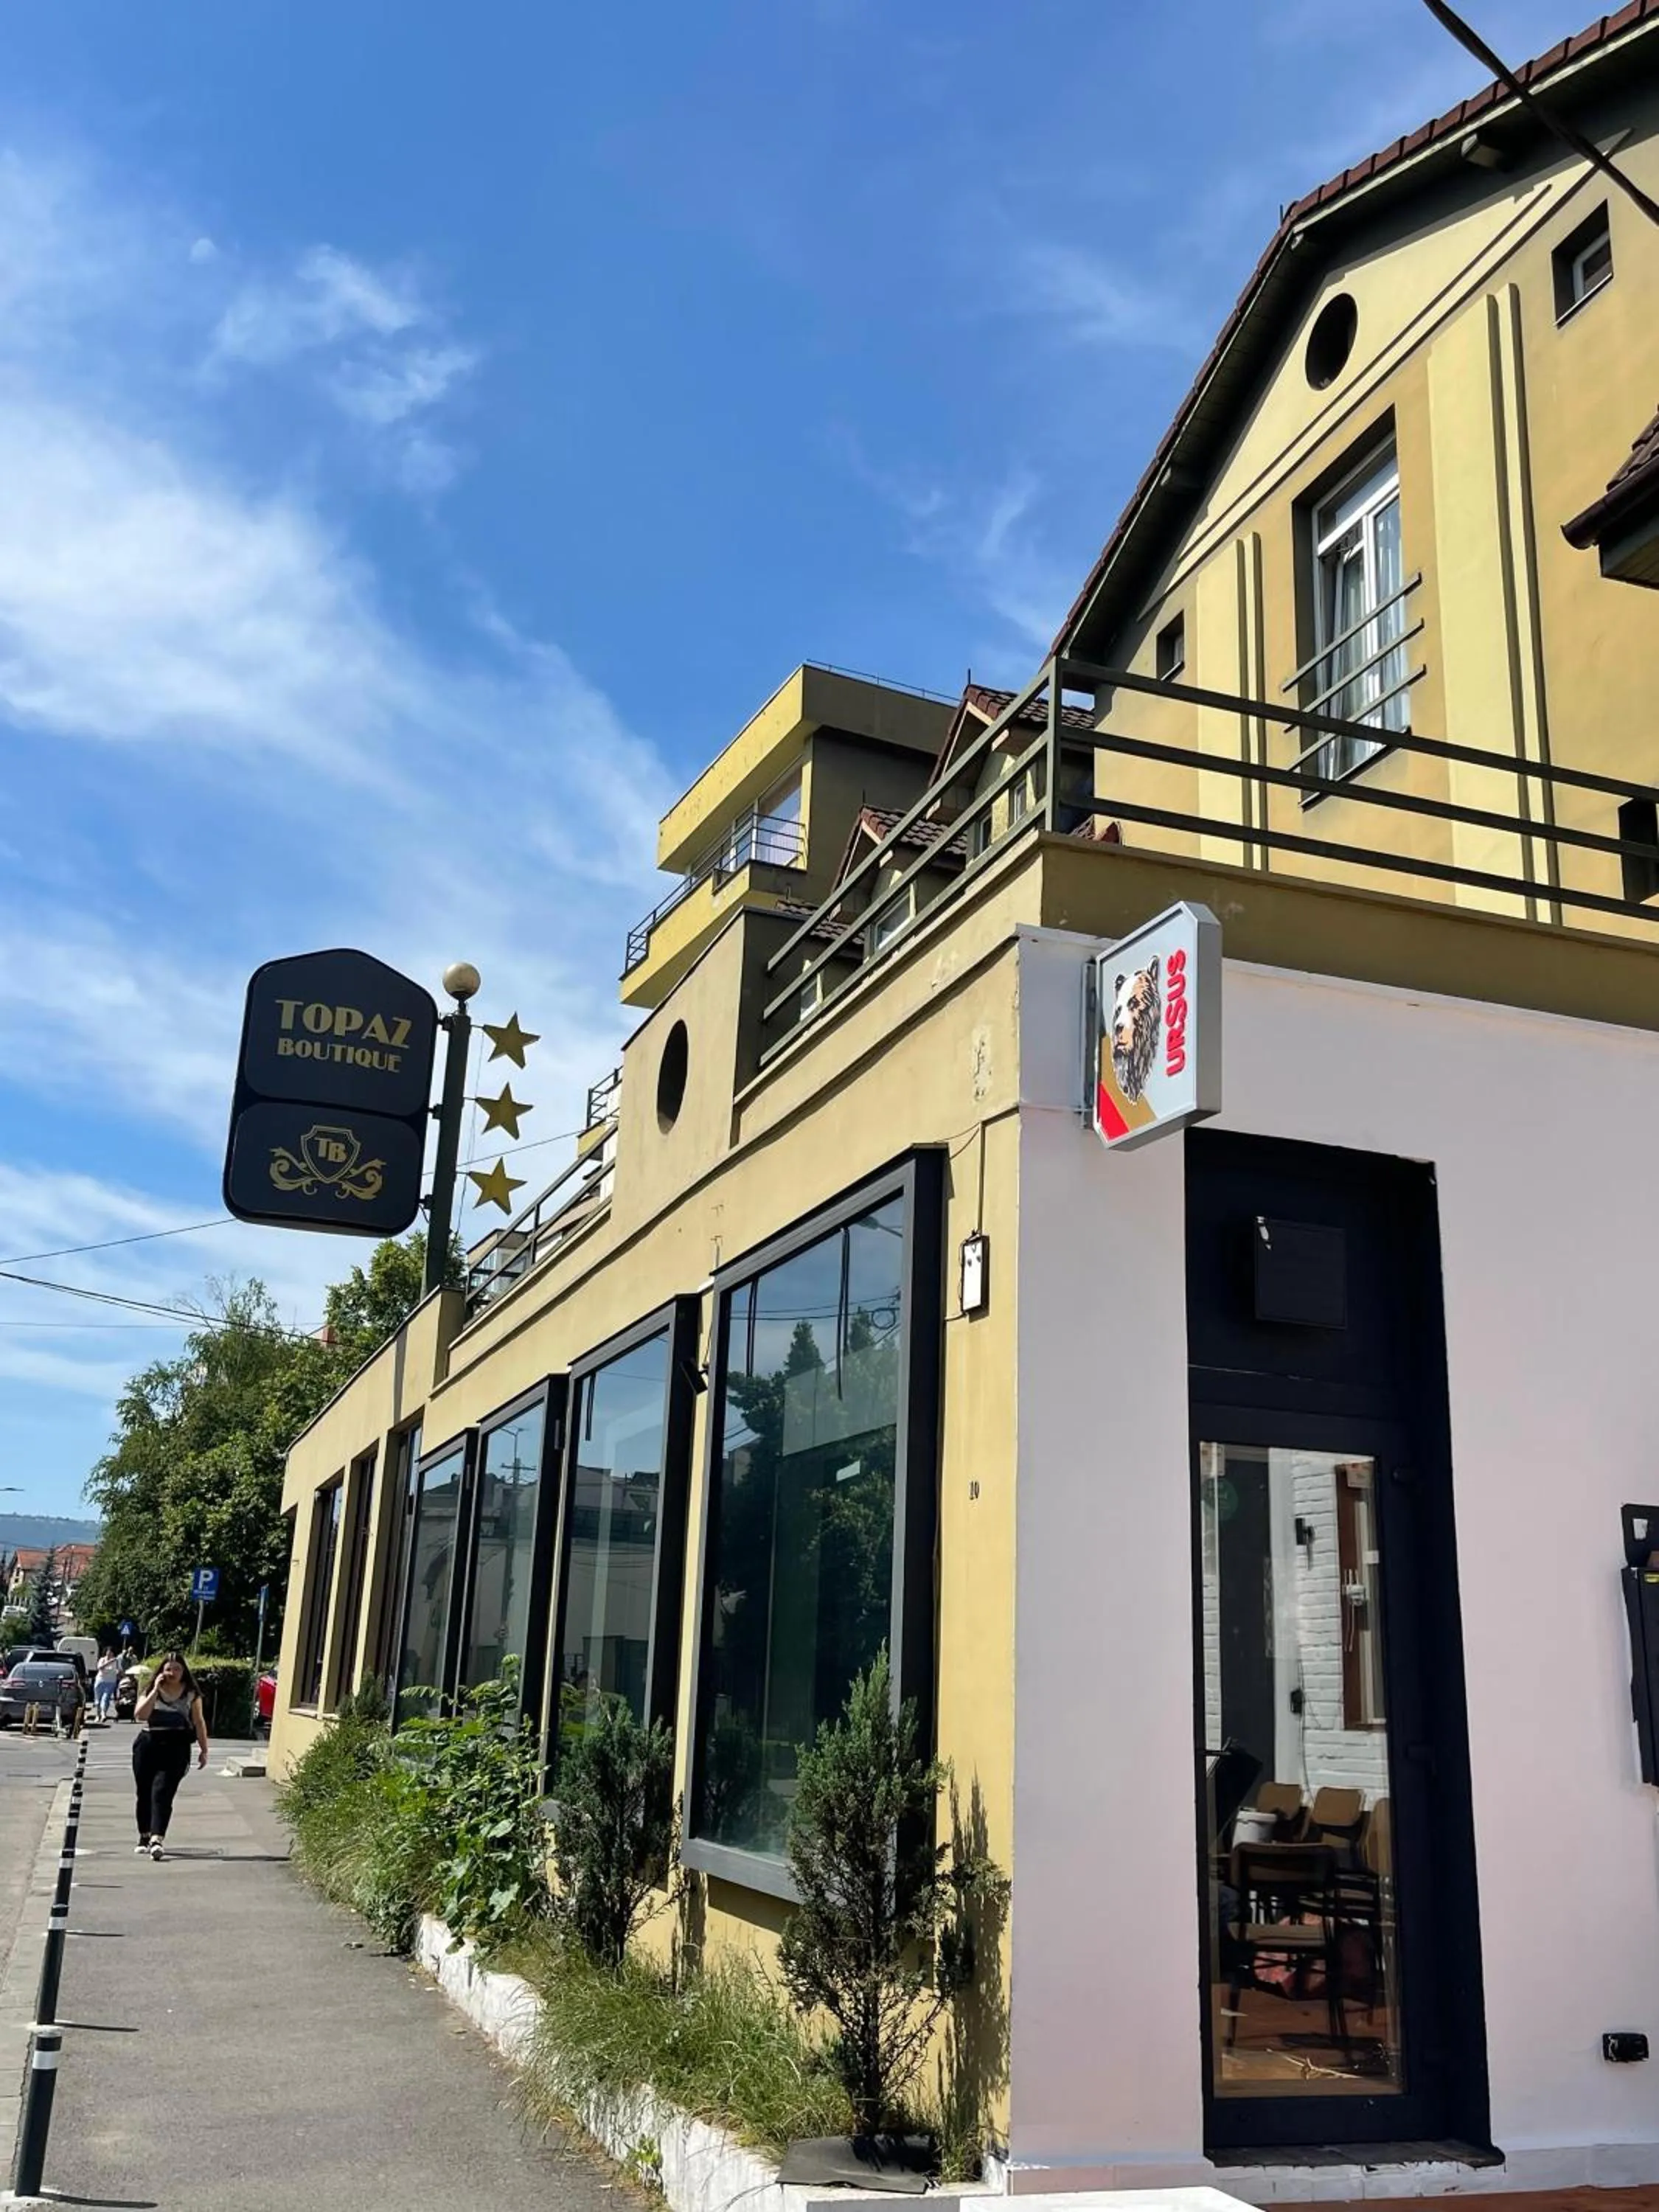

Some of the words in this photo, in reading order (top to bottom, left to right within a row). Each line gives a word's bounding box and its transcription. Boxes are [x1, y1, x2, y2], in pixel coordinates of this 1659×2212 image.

[274, 999, 412, 1049] TOPAZ
[1165, 948, 1188, 1077] URSUS
[277, 1037, 403, 1074] BOUTIQUE
[314, 1136, 347, 1163] TB
[198, 1570, 214, 1589] P
